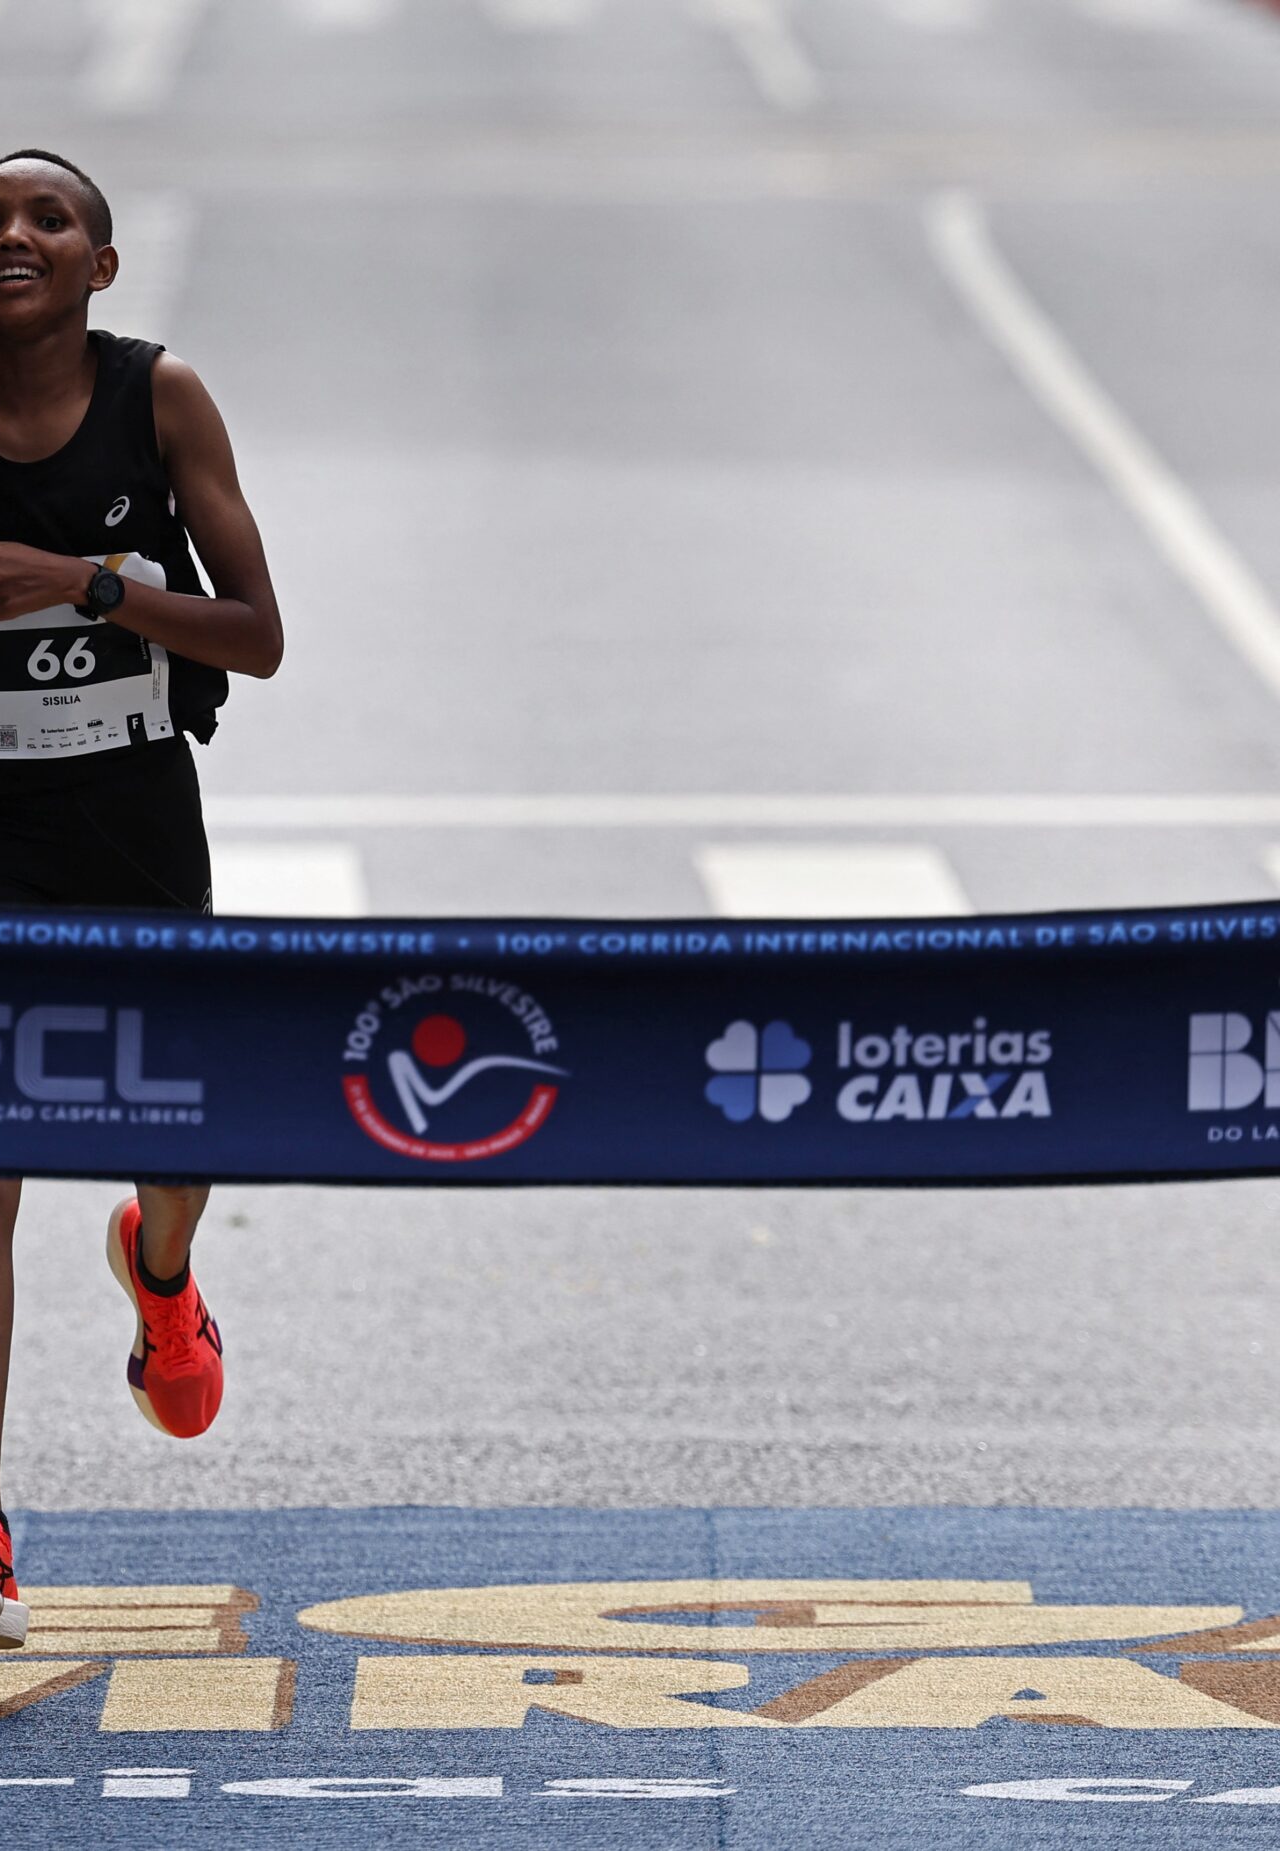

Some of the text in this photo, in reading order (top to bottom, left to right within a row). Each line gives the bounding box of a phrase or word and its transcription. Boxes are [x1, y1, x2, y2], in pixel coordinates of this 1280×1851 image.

[27, 636, 96, 681] 66
[42, 695, 81, 707] SISILIA
[132, 717, 139, 730] F
[136, 927, 176, 949] DE
[189, 925, 258, 952] SÃO
[270, 931, 436, 954] SILVESTRE
[578, 931, 732, 955] CORRIDA
[745, 927, 1023, 953] INTERNACIONAL
[1035, 926, 1077, 947] DE
[1089, 921, 1157, 945] SÃO
[449, 974, 558, 1055] SILVESTRE
[836, 1015, 1053, 1068] loterias
[836, 1071, 1052, 1123] CAIXA
[1207, 1126, 1243, 1142] DO
